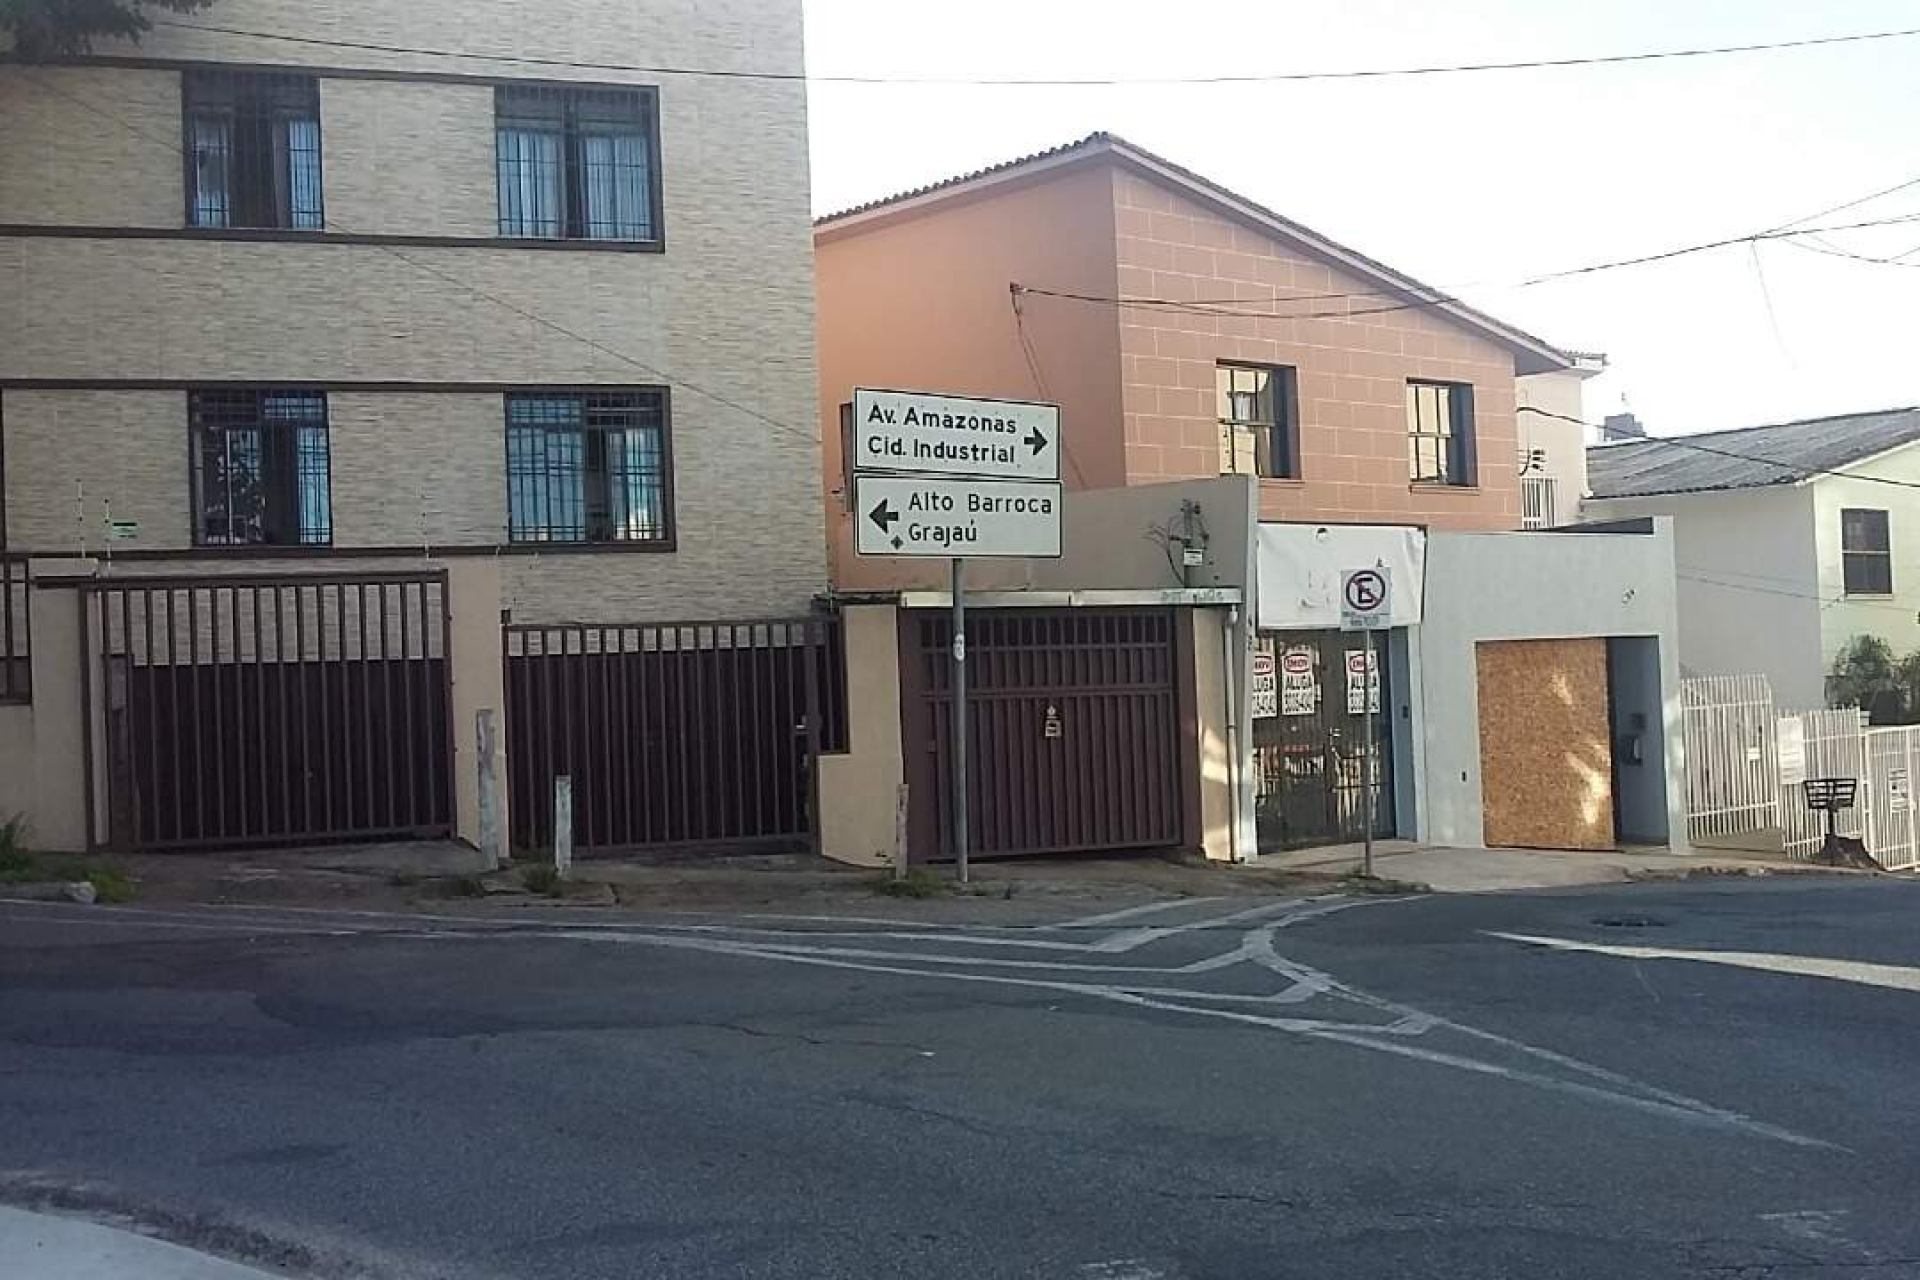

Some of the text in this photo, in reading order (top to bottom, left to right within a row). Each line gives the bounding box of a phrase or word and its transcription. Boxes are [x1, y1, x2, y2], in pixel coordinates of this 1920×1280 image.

[868, 404, 1017, 433] Av. Amazonas
[867, 436, 1015, 463] Cid. Industrial
[908, 492, 1052, 514] Alto Barroca
[908, 519, 977, 548] Grajaú
